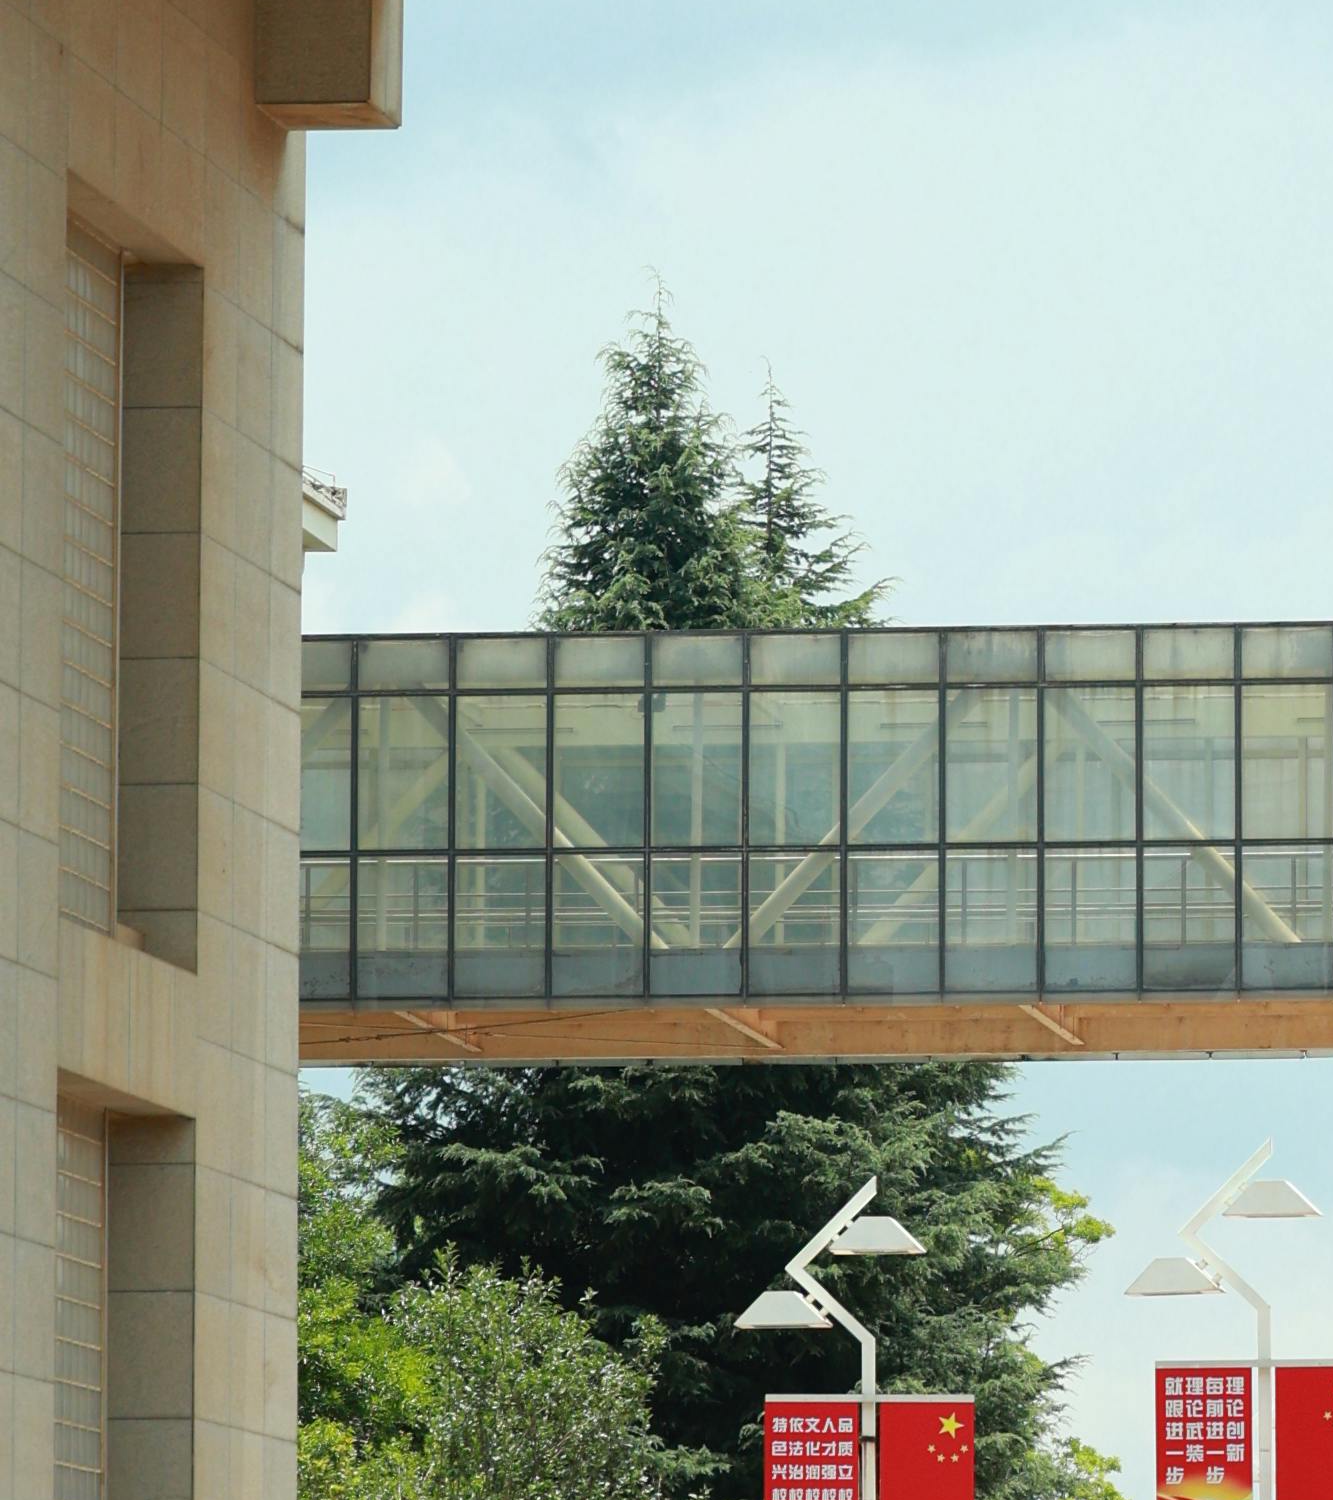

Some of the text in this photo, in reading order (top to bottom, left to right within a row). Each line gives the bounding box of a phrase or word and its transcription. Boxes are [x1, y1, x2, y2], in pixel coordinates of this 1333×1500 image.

[1165, 1377, 1184, 1485] 就跟进一步
[1185, 1377, 1204, 1462] 理论武装
[1206, 1377, 1225, 1485] 每前进一步
[1226, 1376, 1245, 1462] 理论创新
